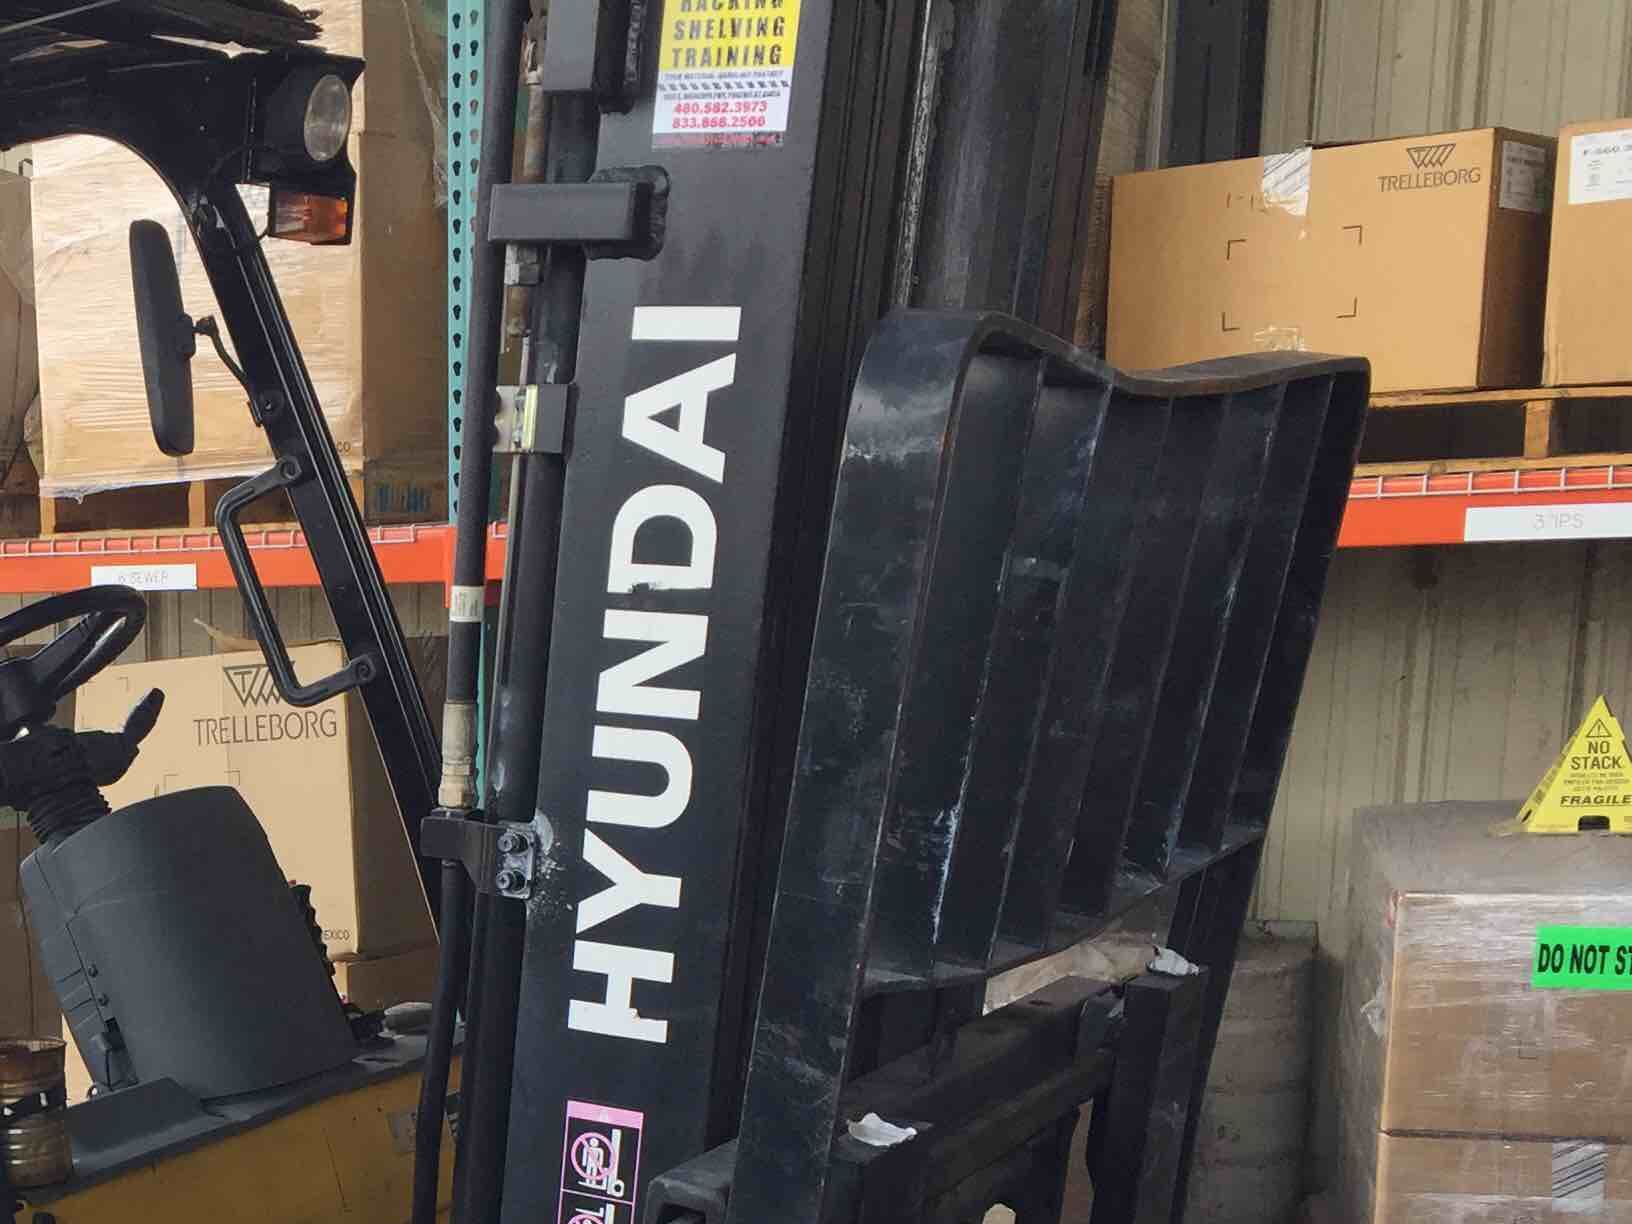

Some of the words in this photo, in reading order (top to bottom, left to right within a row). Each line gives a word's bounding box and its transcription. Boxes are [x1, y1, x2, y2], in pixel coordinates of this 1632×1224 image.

[674, 16, 785, 40] SHELVING
[672, 44, 782, 68] TRAINING
[1378, 167, 1481, 192] TRELLEBORG
[567, 306, 742, 1044] HYUNDAI
[193, 709, 337, 746] TRELLEBORG
[1588, 741, 1610, 754] NO
[1570, 756, 1622, 769] STACK
[1560, 795, 1632, 805] FRAGILE
[1537, 943, 1564, 973] DO
[1569, 944, 1610, 975] NOT
